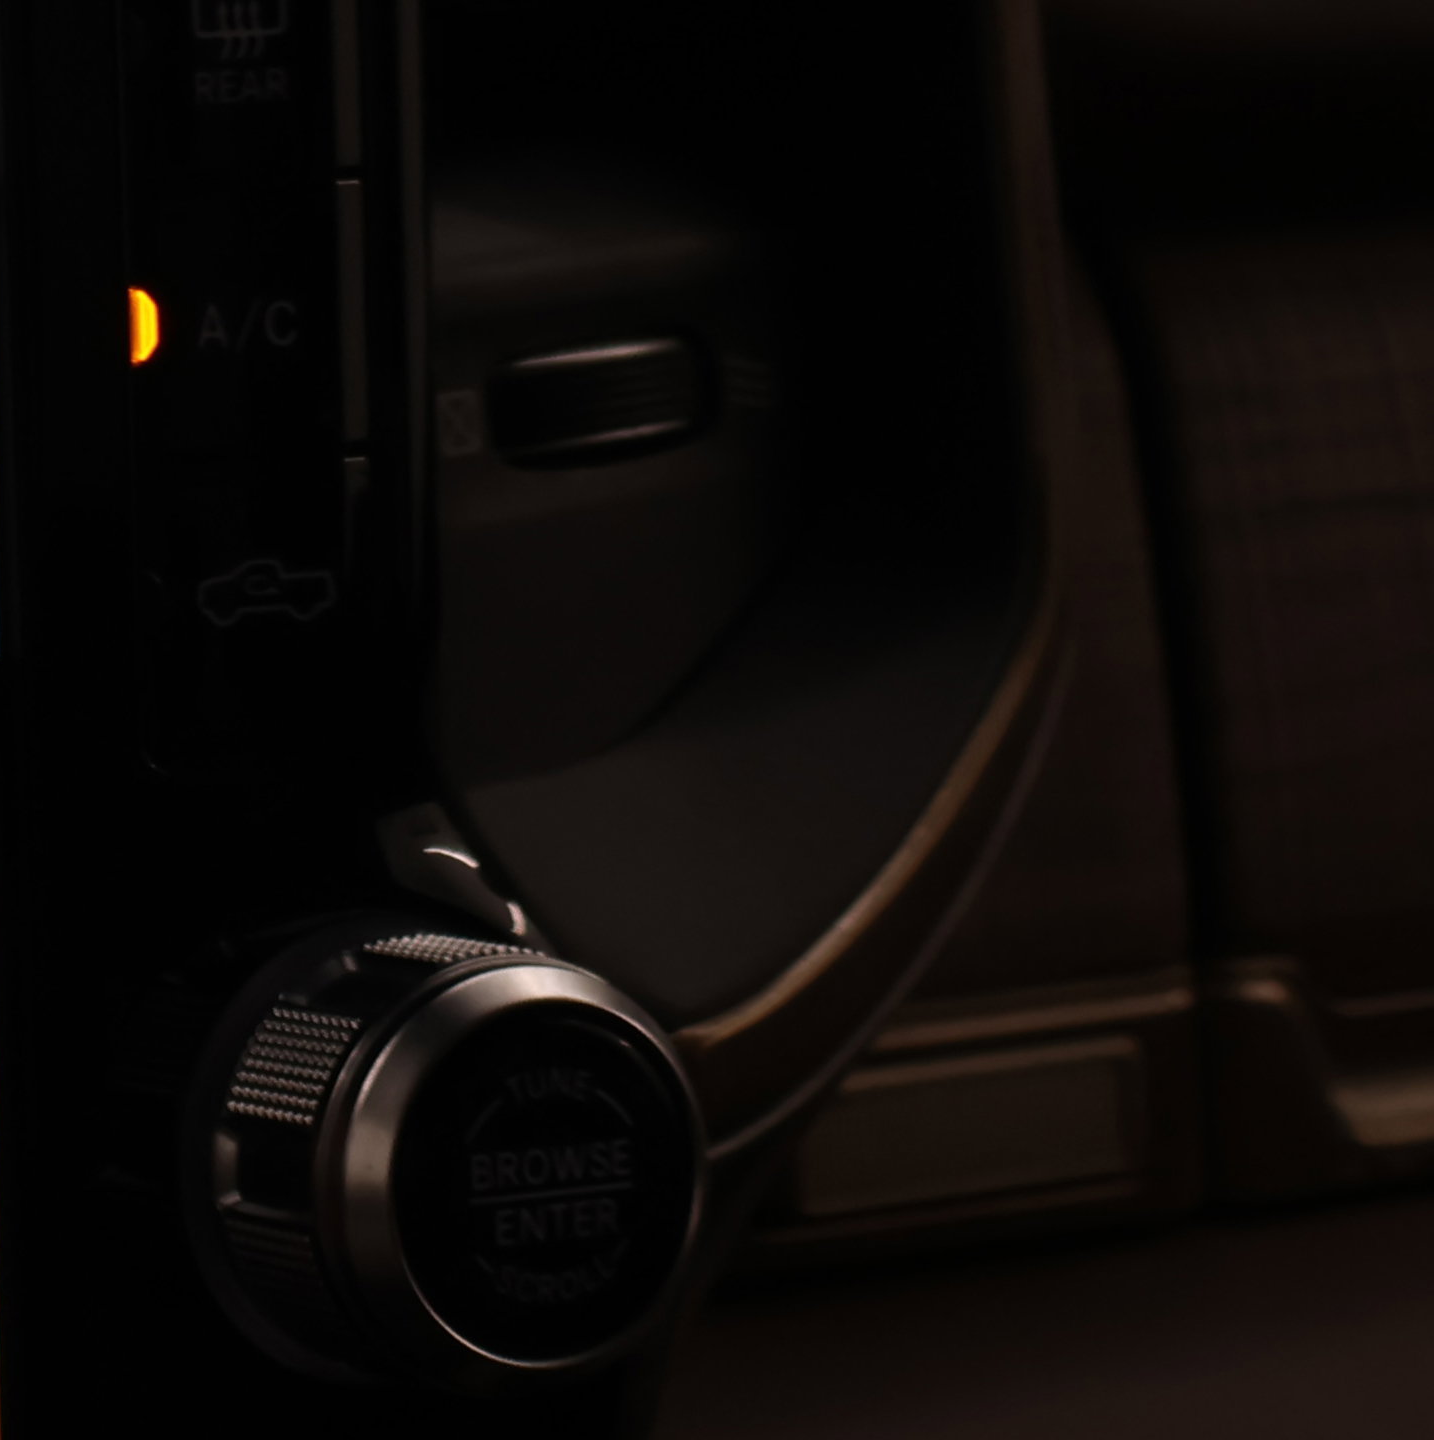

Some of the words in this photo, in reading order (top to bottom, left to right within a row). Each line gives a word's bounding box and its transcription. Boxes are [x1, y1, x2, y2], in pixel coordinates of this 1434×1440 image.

[194, 68, 290, 106] REAR
[195, 298, 299, 350] A/C
[504, 1064, 597, 1104] TUNE
[468, 1136, 635, 1194] BROWSE
[494, 1196, 620, 1247] ENTER
[495, 1251, 620, 1306] SCROLL
